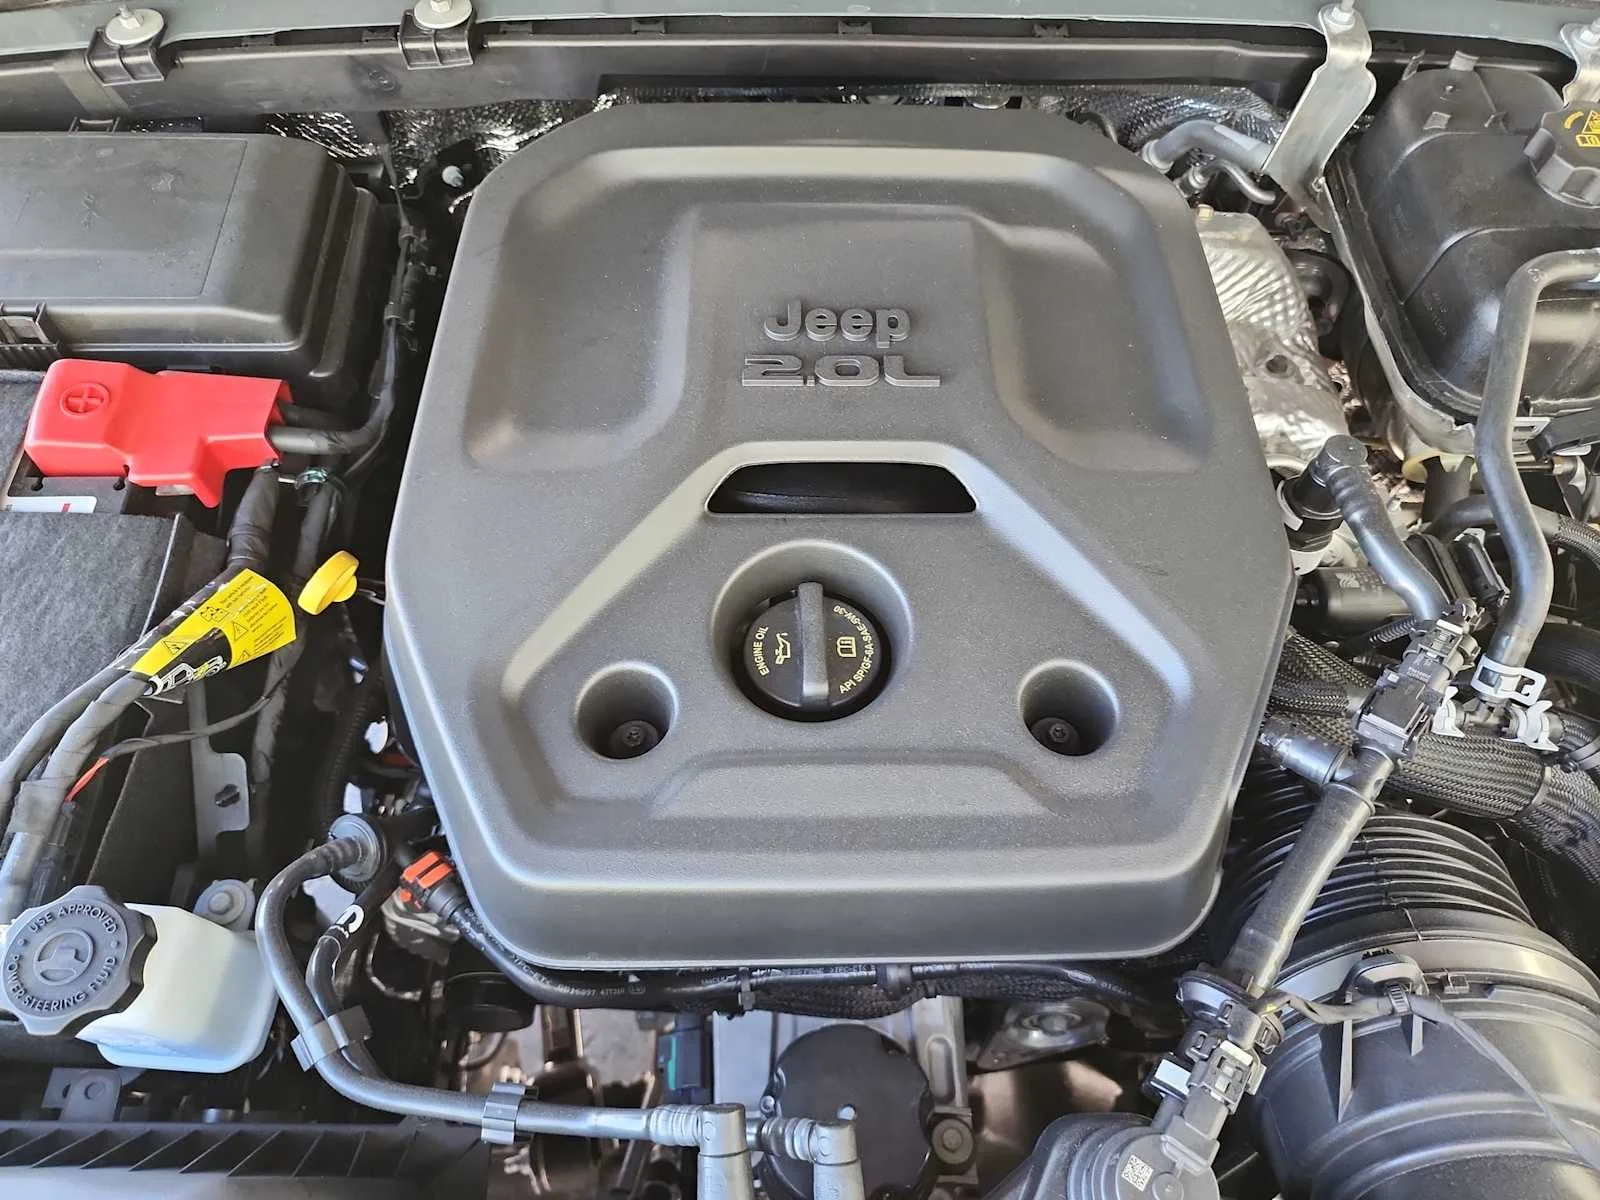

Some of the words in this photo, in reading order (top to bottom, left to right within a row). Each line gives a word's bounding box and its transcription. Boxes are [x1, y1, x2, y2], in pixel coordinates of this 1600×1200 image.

[763, 300, 911, 348] Jeep
[742, 354, 941, 387] 2.0L
[755, 625, 769, 641] OIL
[752, 641, 770, 676] ENGINE
[839, 679, 857, 694] API
[28, 912, 54, 933] USE
[57, 904, 119, 934] APPROVED
[7, 953, 27, 1001] POWER
[23, 991, 89, 1012] STEERING
[89, 956, 118, 993] FLUID
